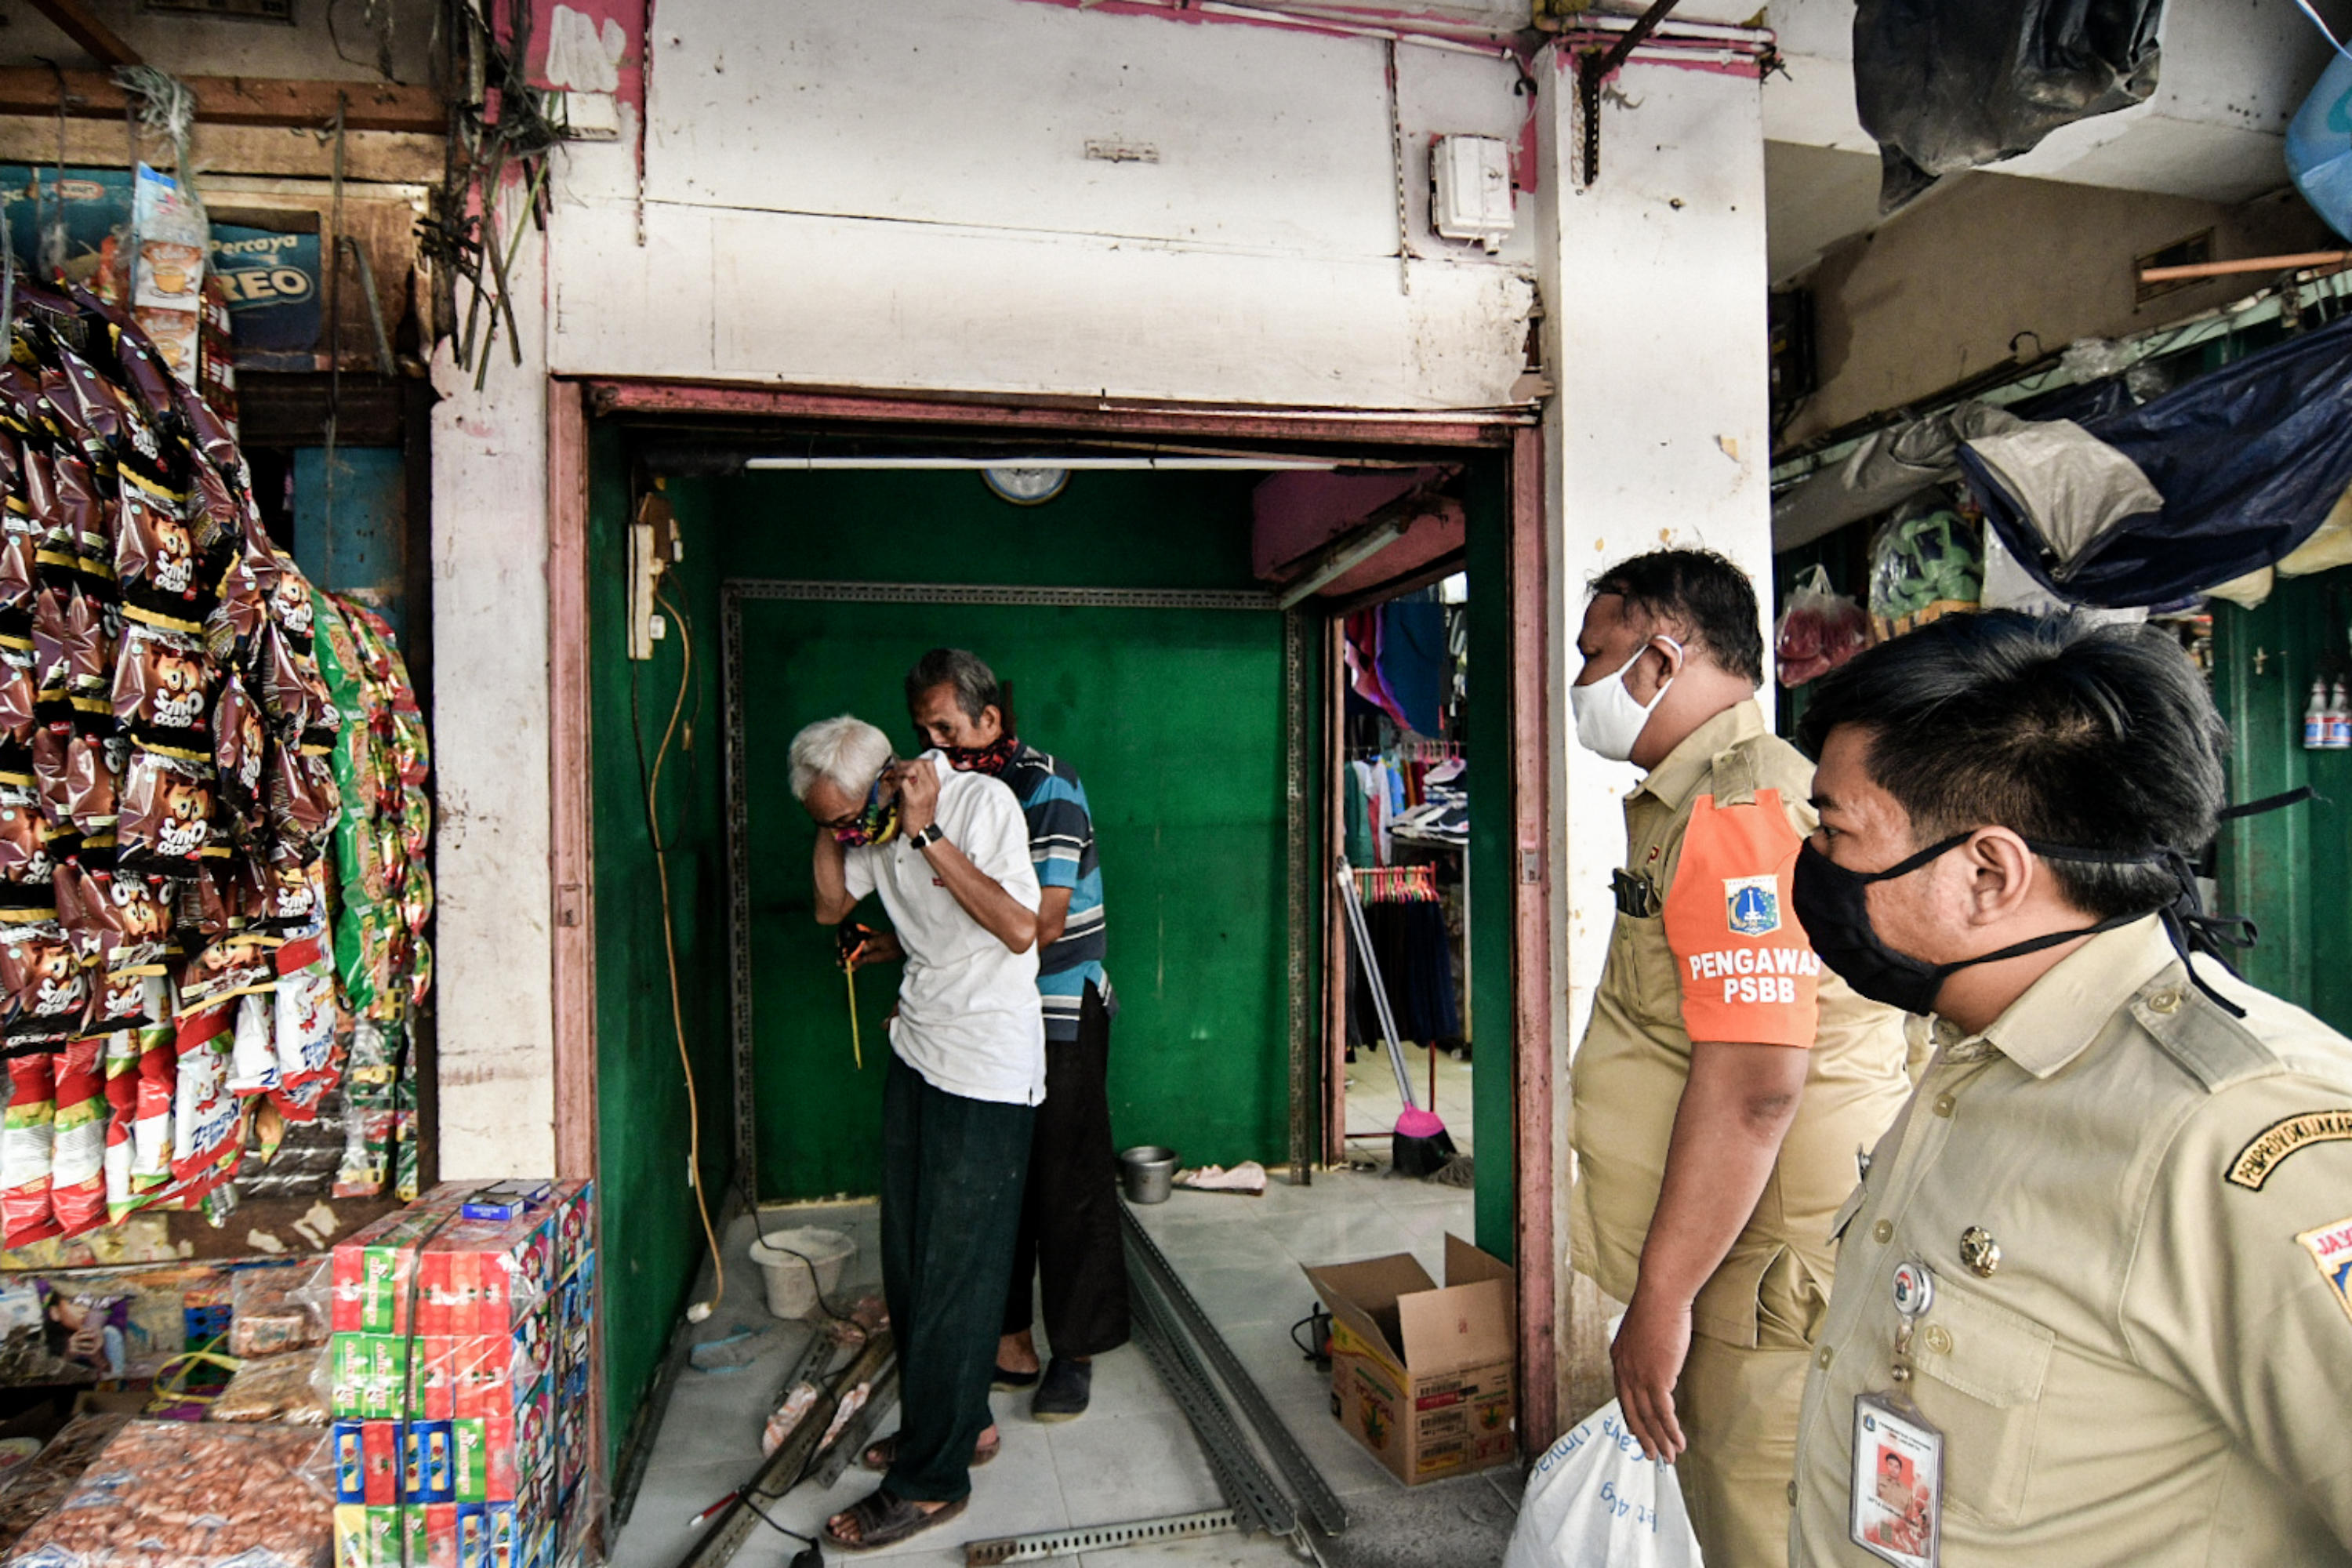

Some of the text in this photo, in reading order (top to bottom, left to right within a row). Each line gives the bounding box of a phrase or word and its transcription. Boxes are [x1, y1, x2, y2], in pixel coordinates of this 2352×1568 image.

[218, 270, 308, 301] REO
[1689, 947, 1821, 981] PENGAWAS
[1724, 977, 1795, 1004] PSBB
